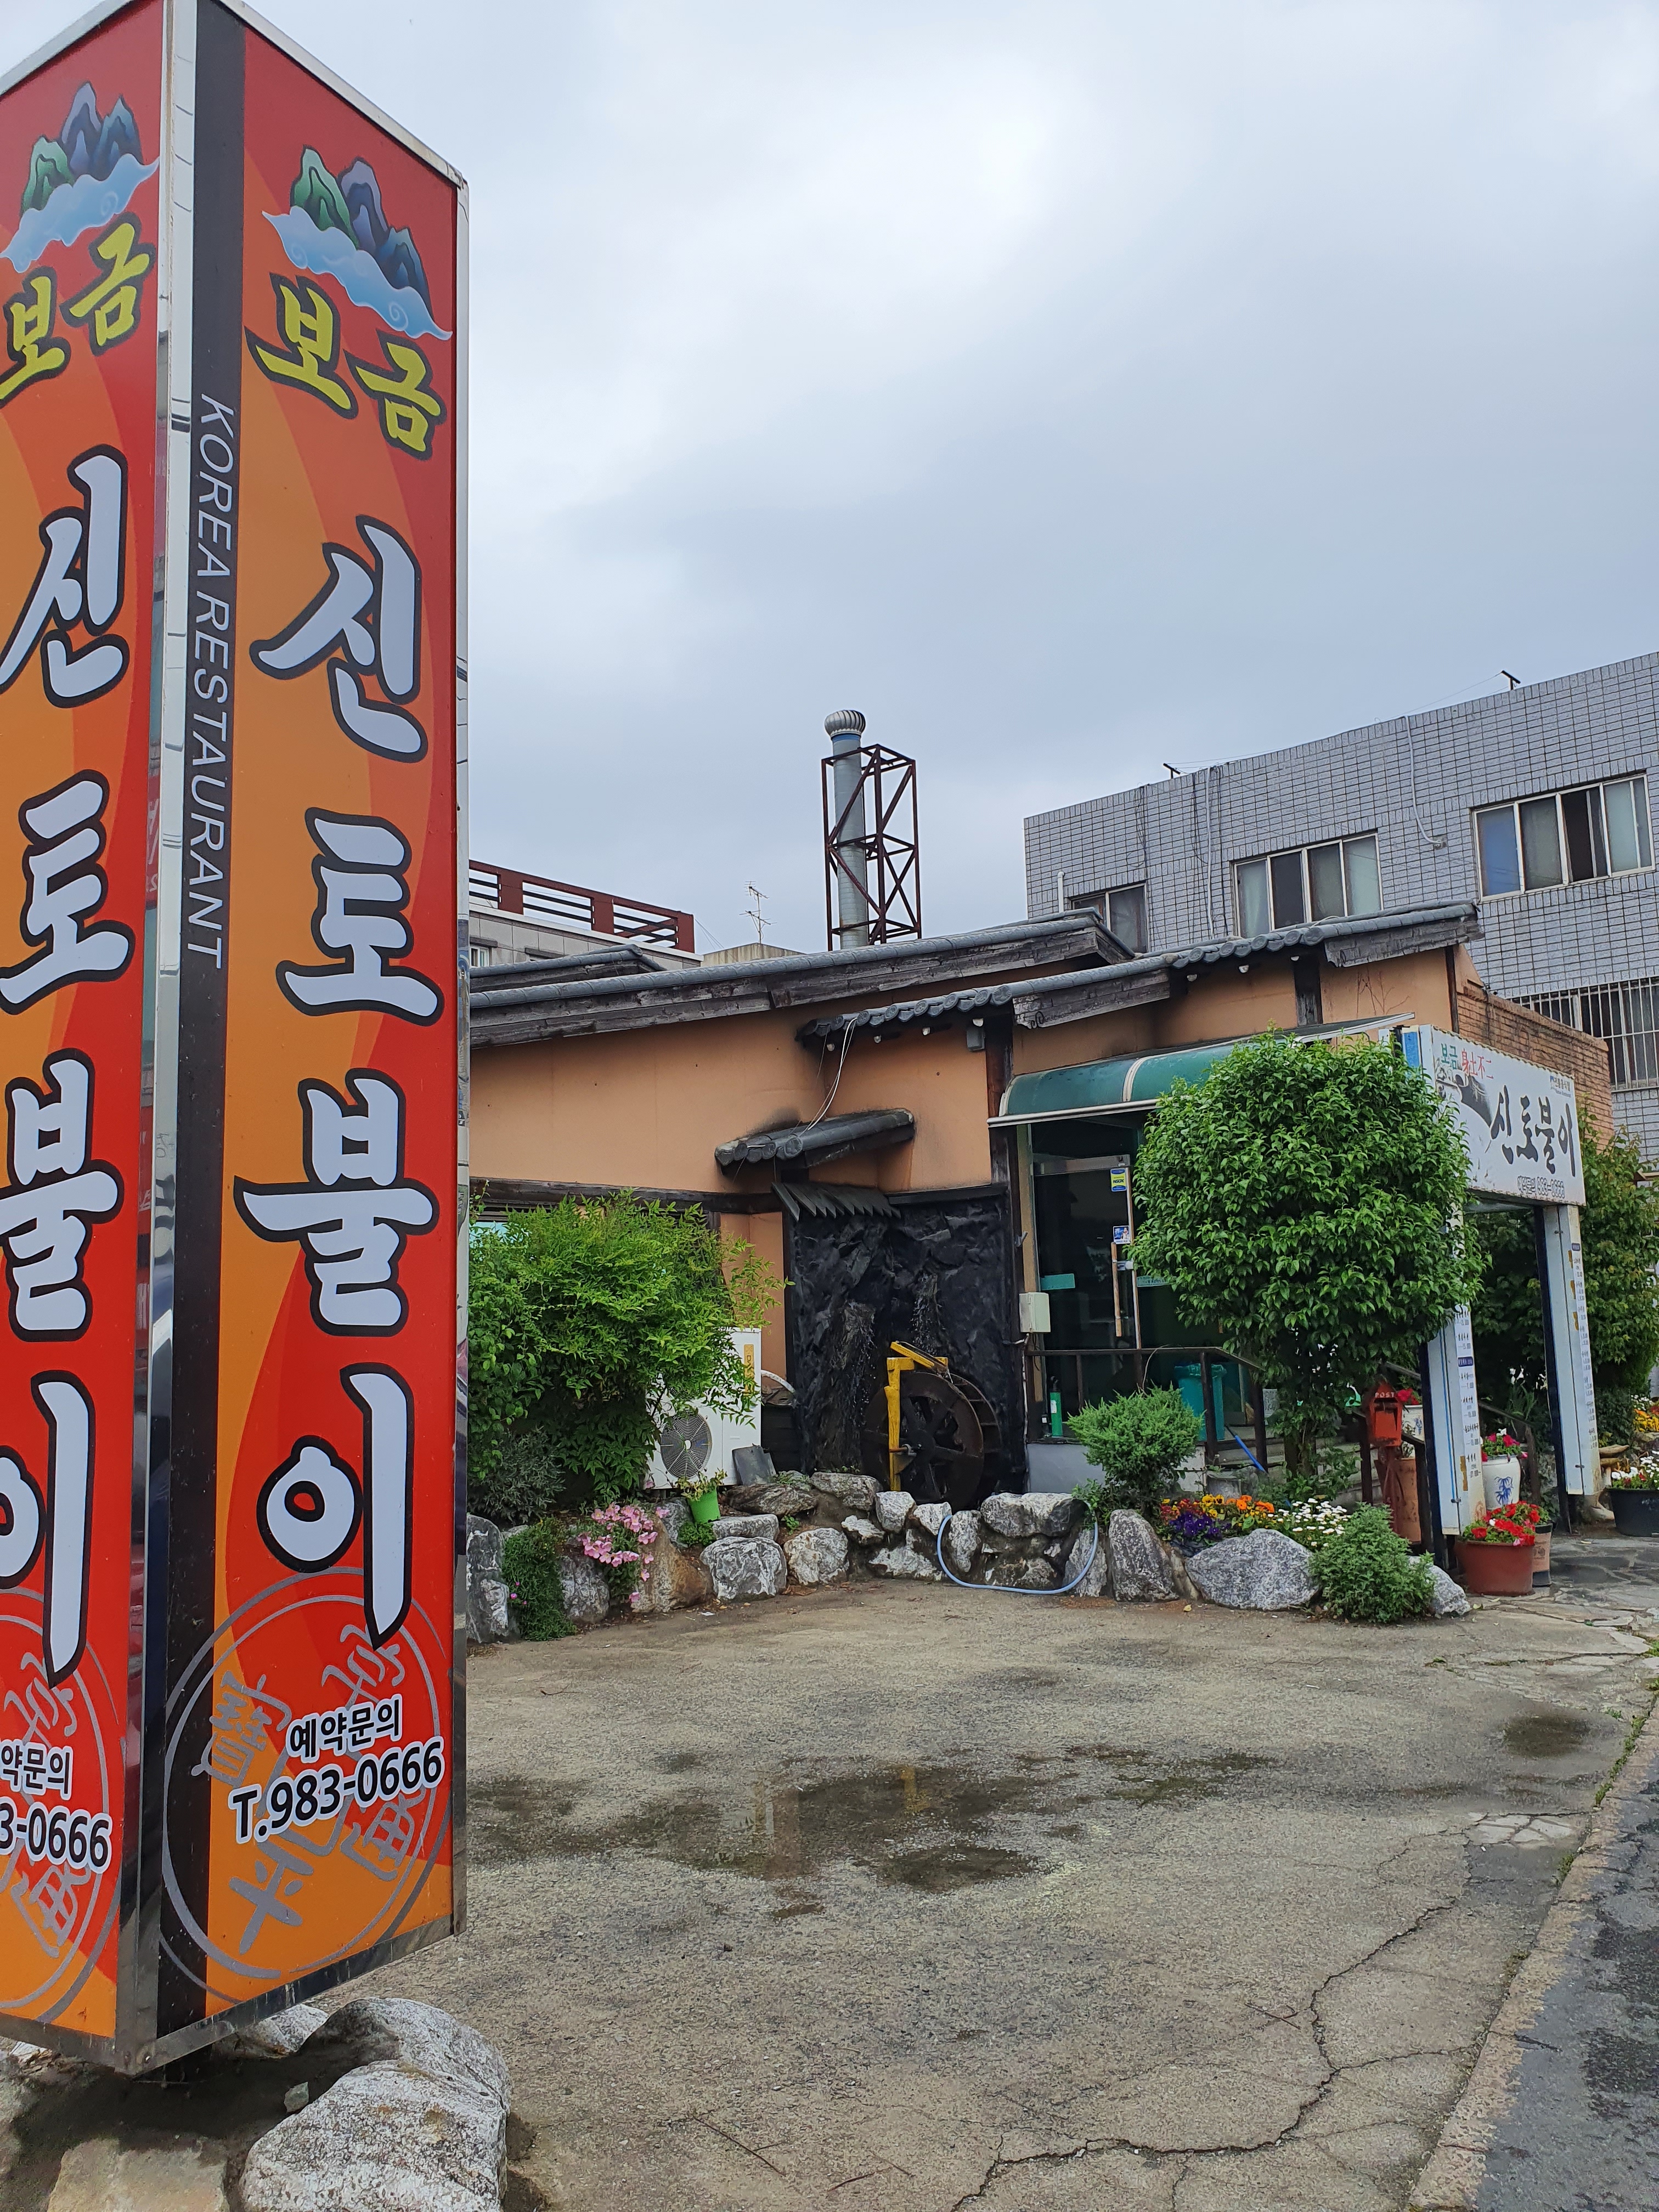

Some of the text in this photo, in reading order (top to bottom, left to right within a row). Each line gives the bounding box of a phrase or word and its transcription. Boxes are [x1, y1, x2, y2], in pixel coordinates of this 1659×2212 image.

[0, 212, 156, 408] 보금
[245, 273, 447, 460] 보금
[187, 393, 234, 969] KOREA RESTAURANT
[235, 516, 443, 1649] 신토불이
[1441, 1043, 1458, 1070] 보금
[1461, 1048, 1494, 1079] 身土不二
[1490, 1085, 1576, 1177] 신토불이
[1537, 1176, 1565, 1199] 983-0666
[289, 1697, 402, 1760] 예약문의
[231, 1739, 443, 1841] T.983-0666
